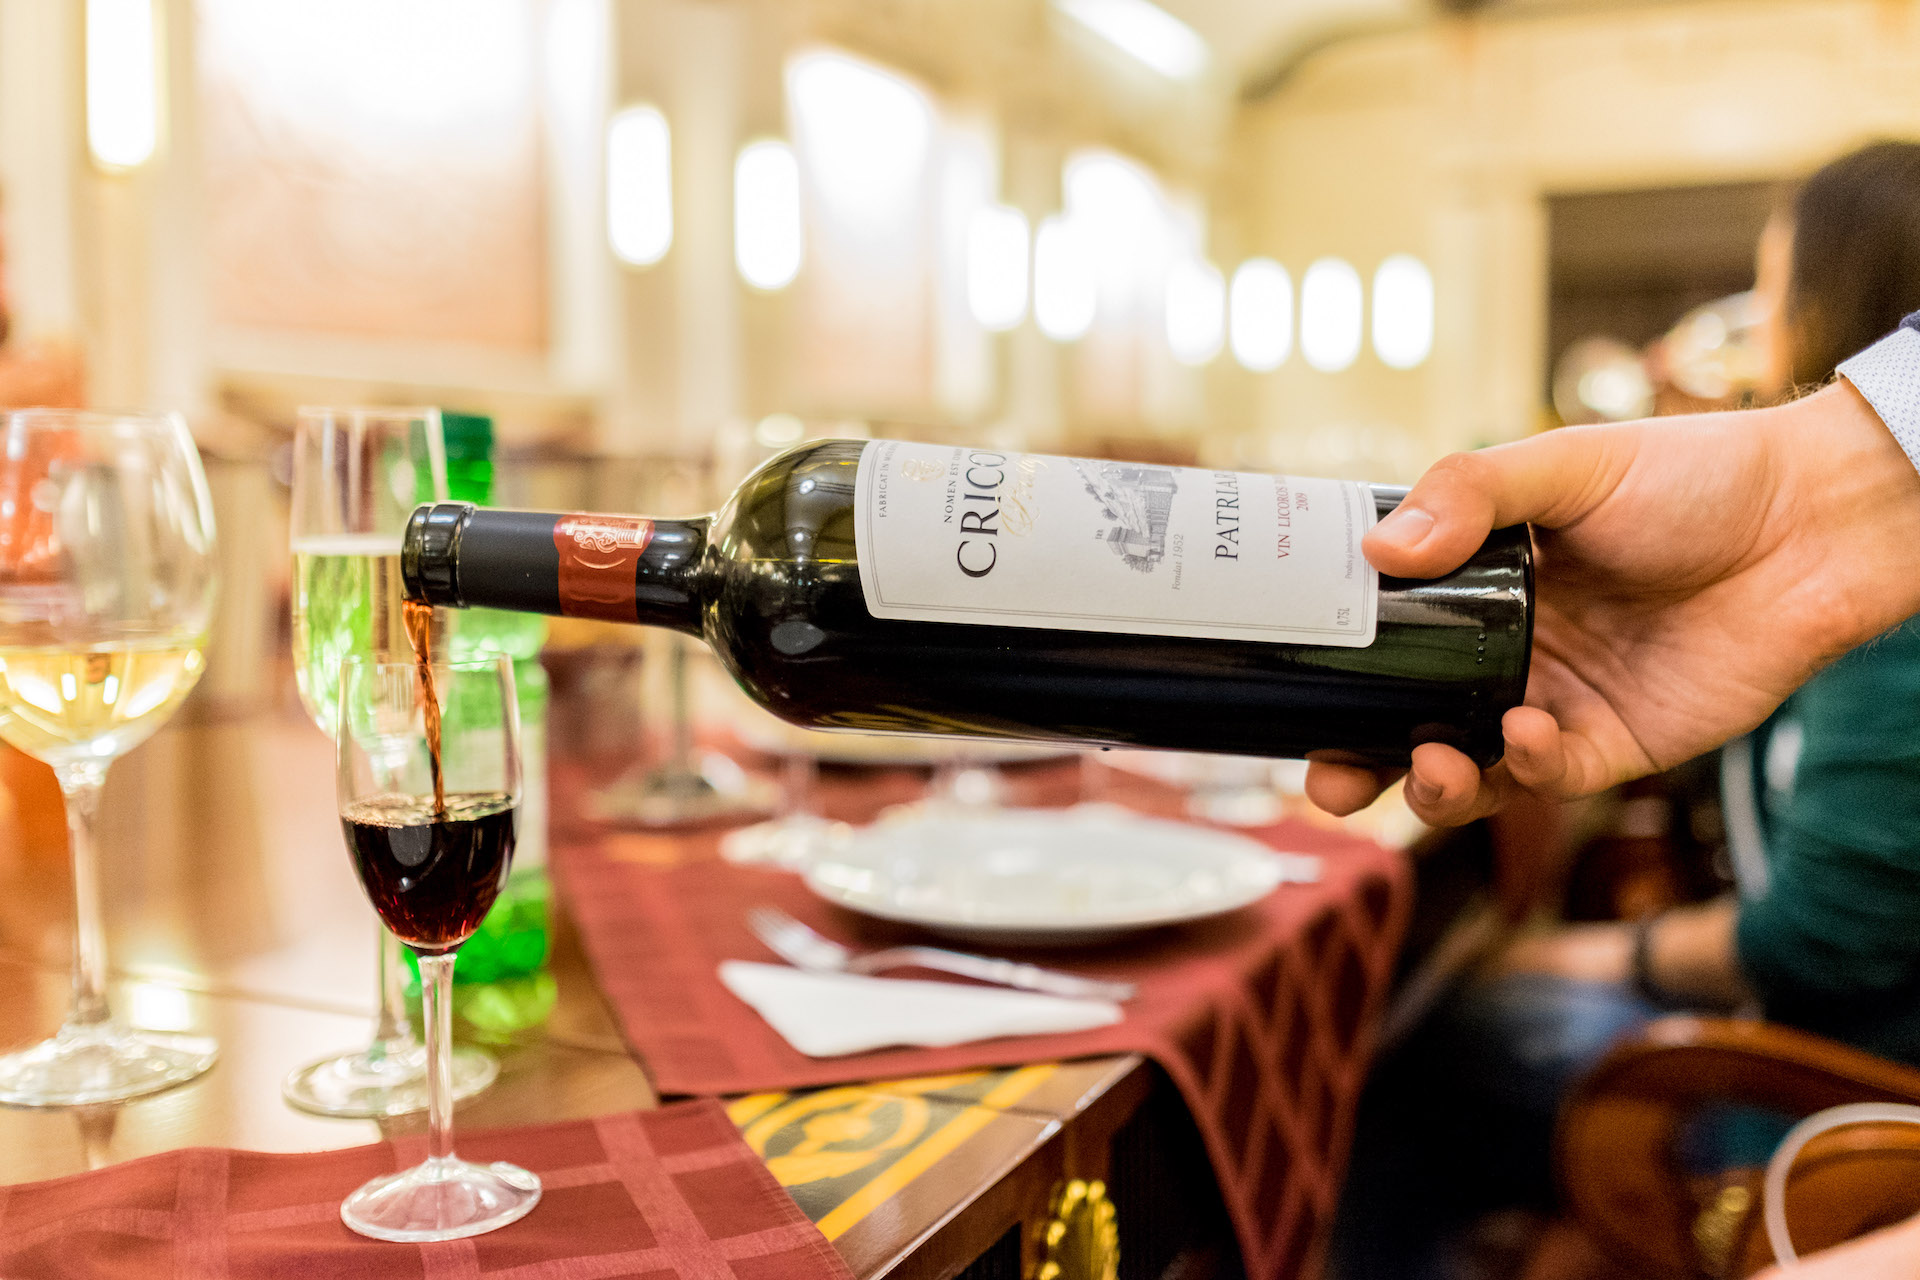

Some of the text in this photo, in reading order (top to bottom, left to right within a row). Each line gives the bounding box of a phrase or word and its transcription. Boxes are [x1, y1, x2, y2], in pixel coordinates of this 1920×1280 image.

[879, 473, 889, 518] FABRICAT
[944, 479, 956, 524] NOMEN
[950, 462, 960, 476] EST
[957, 450, 1007, 578] CRICO
[1215, 472, 1240, 562] PATRIAR
[1277, 486, 1291, 528] LICOROS
[1297, 492, 1309, 512] 2009
[1172, 534, 1184, 591] Fondat 1952
[1278, 533, 1291, 559] VIN
